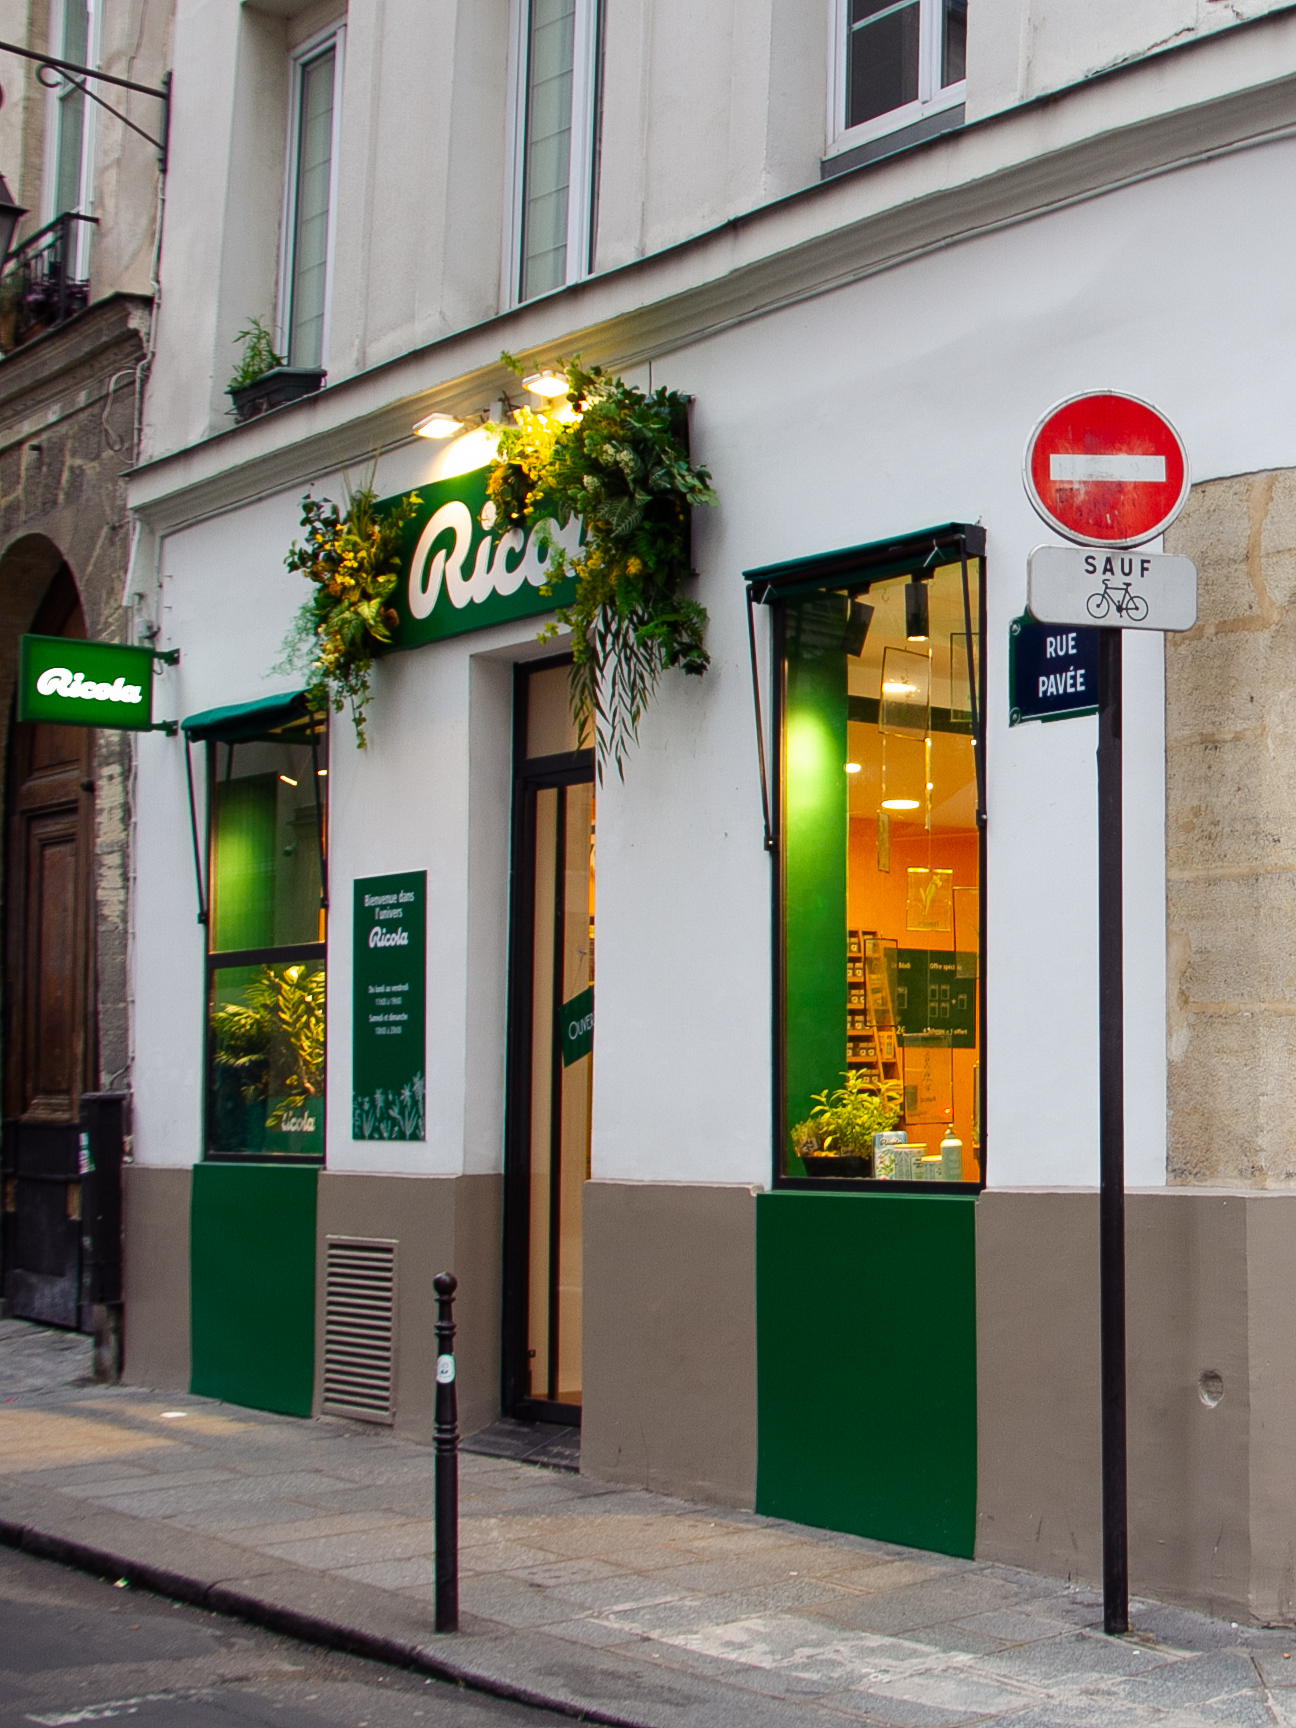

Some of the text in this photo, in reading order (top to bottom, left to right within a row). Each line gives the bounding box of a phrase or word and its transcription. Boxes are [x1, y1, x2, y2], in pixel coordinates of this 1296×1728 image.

[1084, 555, 1151, 578] SAUF
[1046, 633, 1077, 658] RUE
[36, 667, 143, 704] Ricola
[1038, 666, 1086, 698] PAVÉE
[363, 889, 415, 907] Bienvenue dans
[368, 926, 408, 948] Ricola
